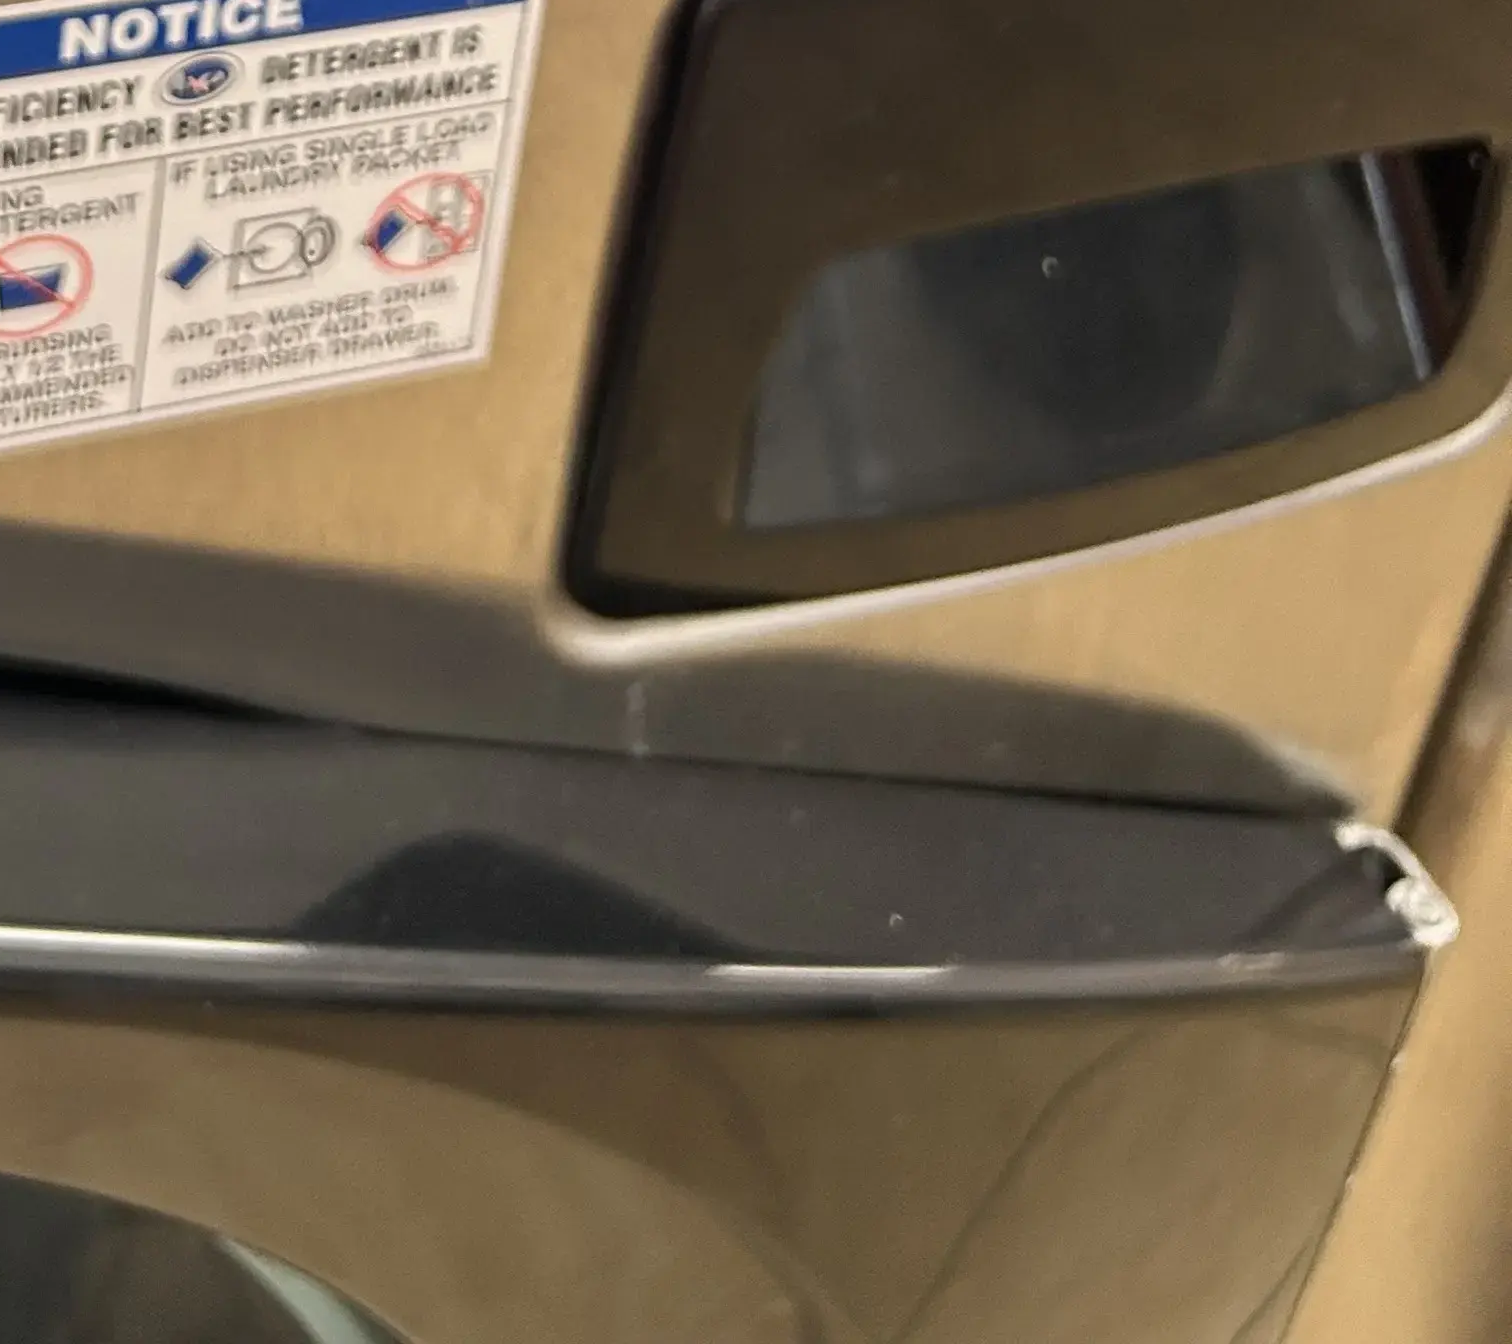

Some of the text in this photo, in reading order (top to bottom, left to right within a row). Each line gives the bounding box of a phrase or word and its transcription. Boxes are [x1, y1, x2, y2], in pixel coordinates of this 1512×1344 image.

[261, 29, 447, 84] DETERGENT
[450, 24, 484, 57] IS
[99, 116, 163, 153] FOR
[176, 101, 255, 139] BEST
[262, 64, 500, 126] PERFORMANCE
[304, 123, 410, 161] SINGLE
